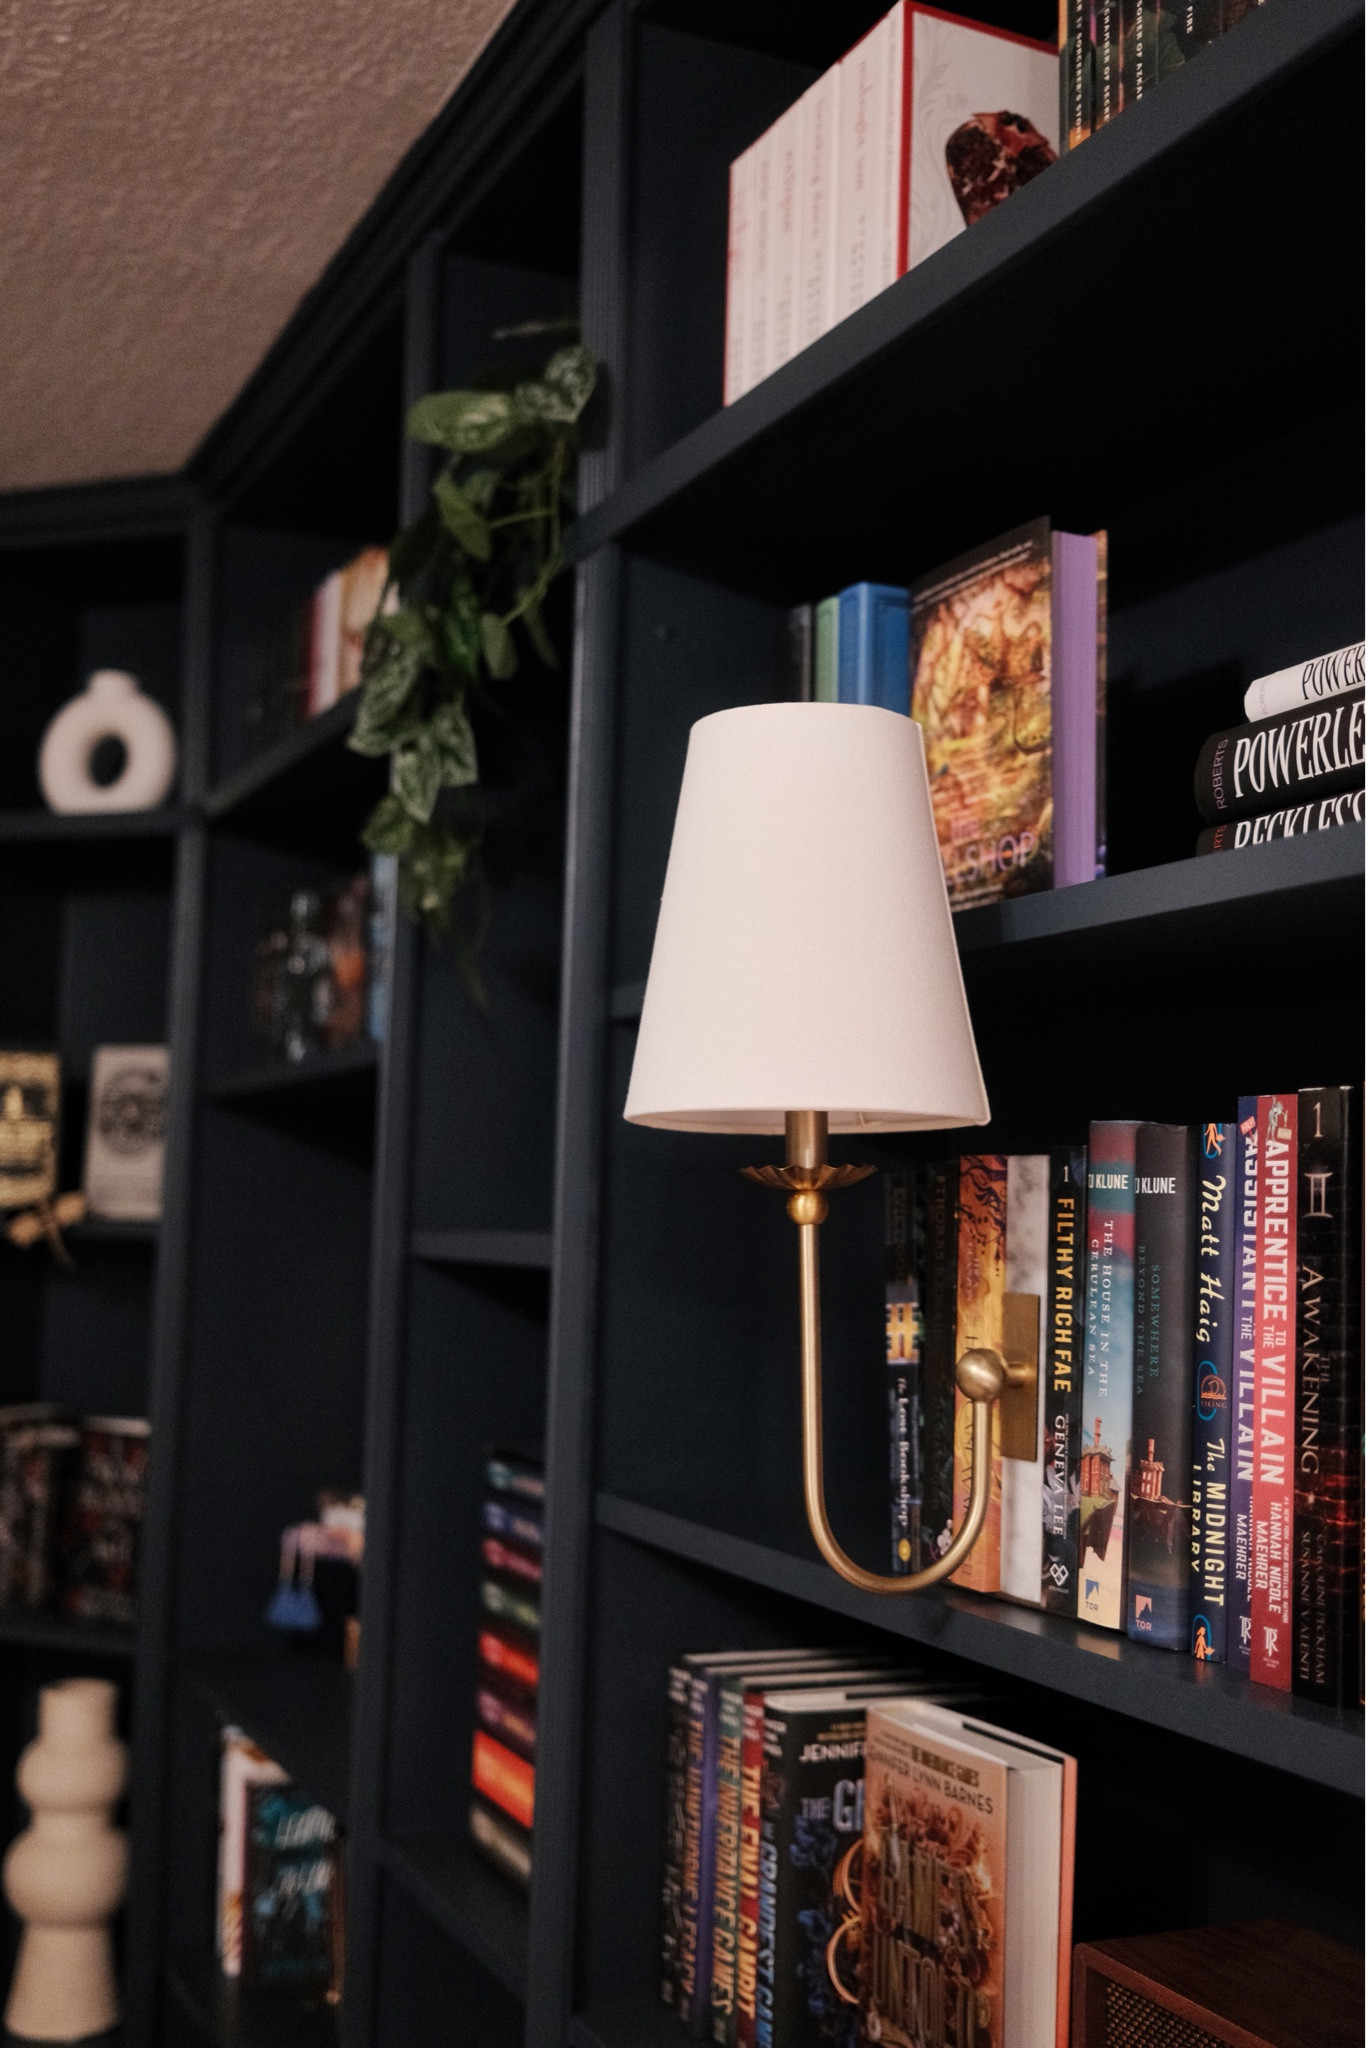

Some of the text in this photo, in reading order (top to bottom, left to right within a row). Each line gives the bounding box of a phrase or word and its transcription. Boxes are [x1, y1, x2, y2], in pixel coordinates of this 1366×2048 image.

[1136, 43, 1143, 58] OF
[1186, 5, 1194, 34] FIRE
[1075, 32, 1083, 101] SORCERER'S
[1103, 66, 1110, 81] OF
[1211, 738, 1229, 810] ROBERTS
[1063, 1165, 1069, 1183] 1
[1095, 1173, 1129, 1190] KLUNE
[1141, 1177, 1176, 1194] KLUNE
[1053, 1198, 1074, 1393] FILTHY RICH FAE
[1196, 1175, 1226, 1343] Matt Haig
[1088, 1239, 1099, 1375] CERULEAN SEA
[1098, 1220, 1113, 1397] THE HOUSE IN THE
[1136, 1245, 1146, 1395] BEYOND THE SEA
[1150, 1264, 1160, 1377] SOMEWHERE
[1241, 1316, 1253, 1341] THE
[1260, 1140, 1289, 1485] APPRENTICE TO THE VILLAIN
[1200, 1399, 1227, 1409] VIKING
[1300, 1265, 1325, 1474] AWAKENING
[1237, 1348, 1255, 1482] VILLAIN
[1053, 1415, 1066, 1536] GENEVA LEE
[1203, 1438, 1227, 1607] The MIDNIGHT
[1236, 1513, 1247, 1581] MAEHRER
[1255, 1520, 1268, 1589] MAEHRER
[1268, 1502, 1282, 1614] HANNAH NICOLE
[1085, 1600, 1099, 1612] TOR
[1135, 1619, 1152, 1632] TOR
[1300, 1530, 1310, 1680] SUSANNE VALENTI
[1315, 1609, 1326, 1684] PECKHAM
